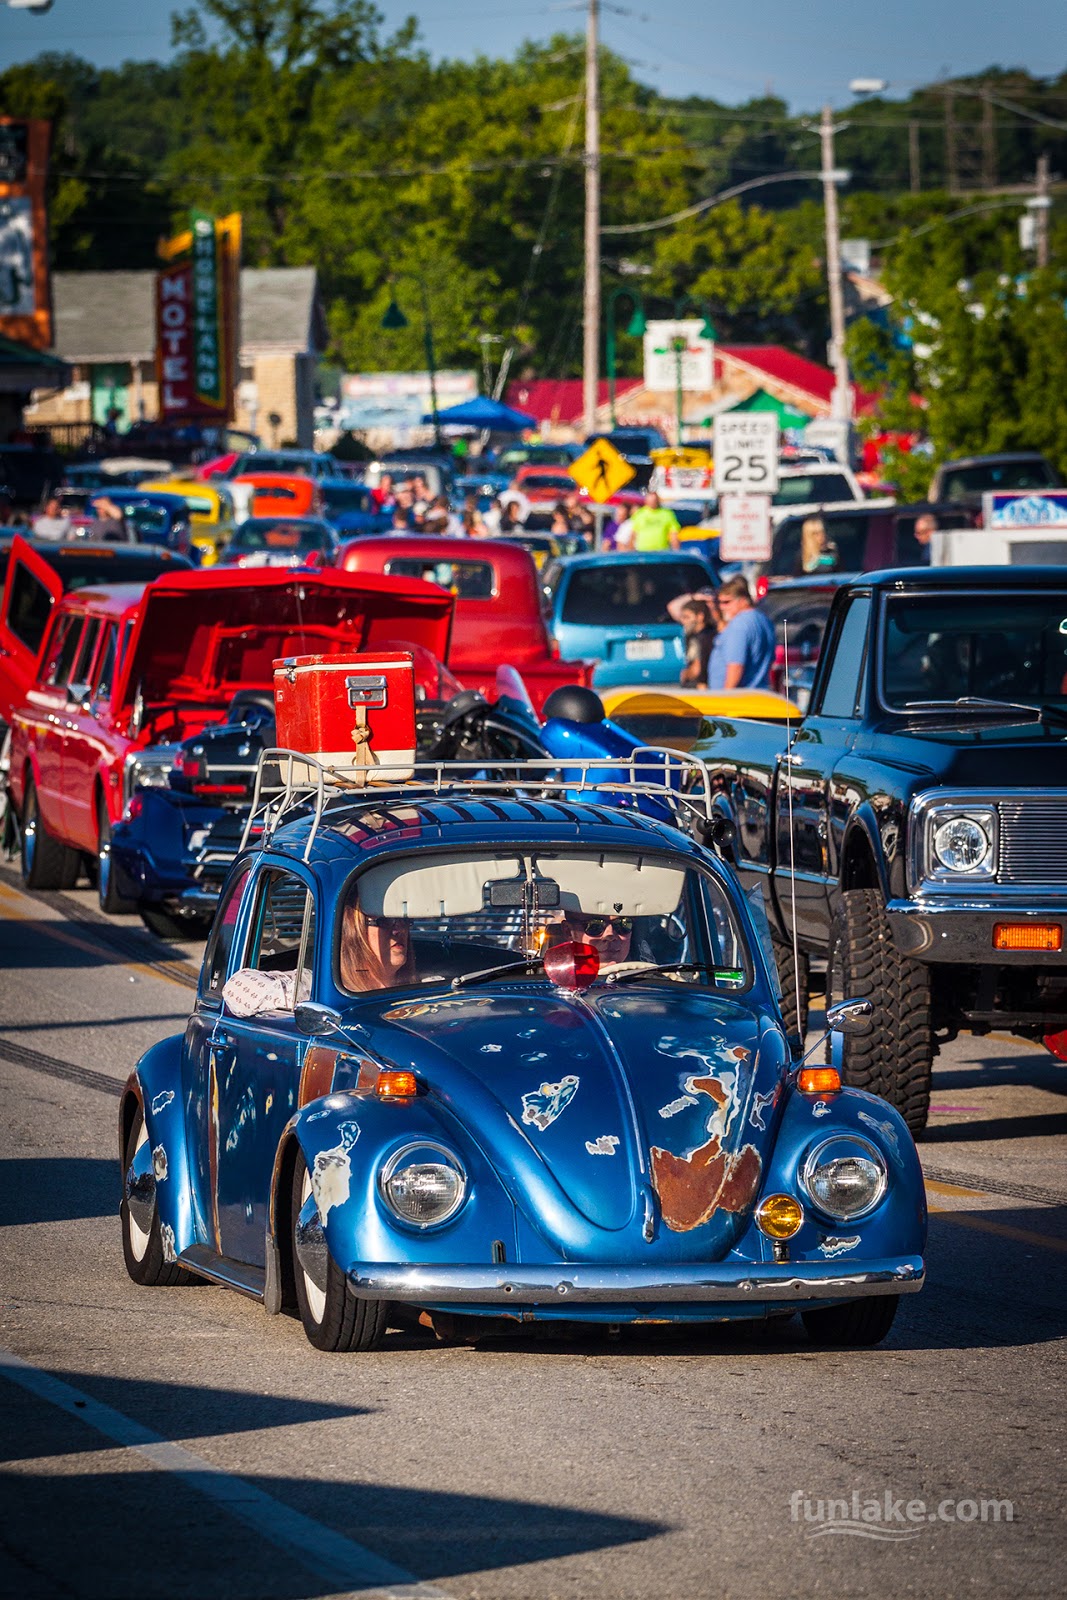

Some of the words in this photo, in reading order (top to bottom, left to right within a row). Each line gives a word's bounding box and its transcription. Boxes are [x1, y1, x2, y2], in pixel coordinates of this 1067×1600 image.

[162, 277, 187, 409] MOTEL
[720, 423, 770, 434] SPEED
[724, 439, 765, 449] LIMIT
[724, 455, 768, 482] 25
